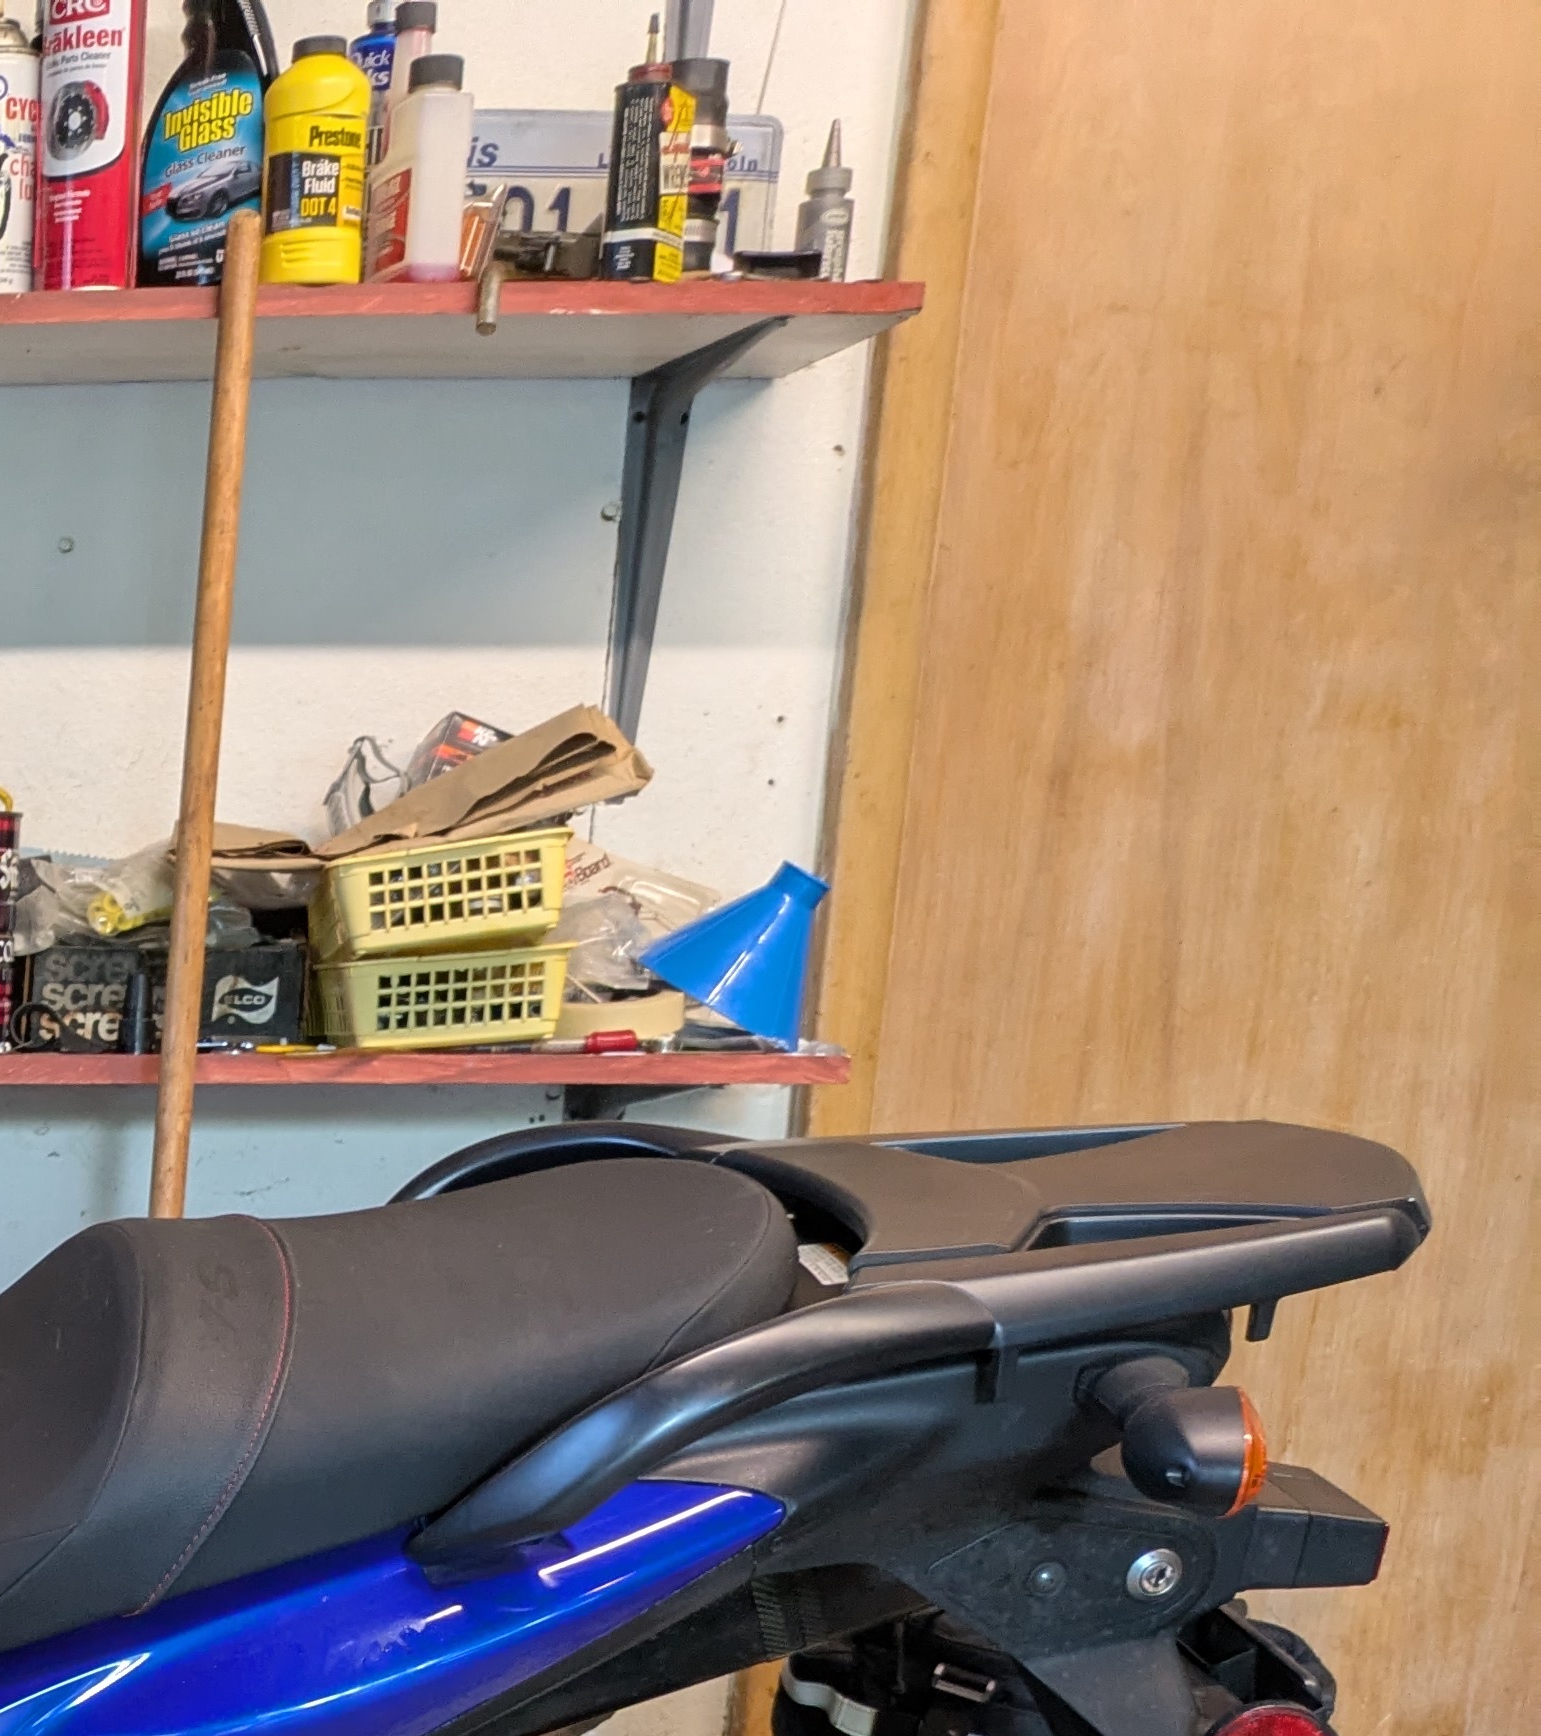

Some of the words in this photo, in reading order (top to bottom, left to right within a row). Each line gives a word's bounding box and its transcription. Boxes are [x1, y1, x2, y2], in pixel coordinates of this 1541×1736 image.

[164, 88, 253, 139] Invisible
[179, 116, 236, 152] Glass
[309, 125, 362, 149] Prestone
[165, 157, 194, 180] Glass
[197, 145, 246, 166] Cleaner
[302, 159, 339, 178] Brake
[304, 177, 336, 195] Fluid
[301, 197, 327, 216] DOT
[328, 197, 337, 216] 4
[224, 994, 265, 1006] ELCO
